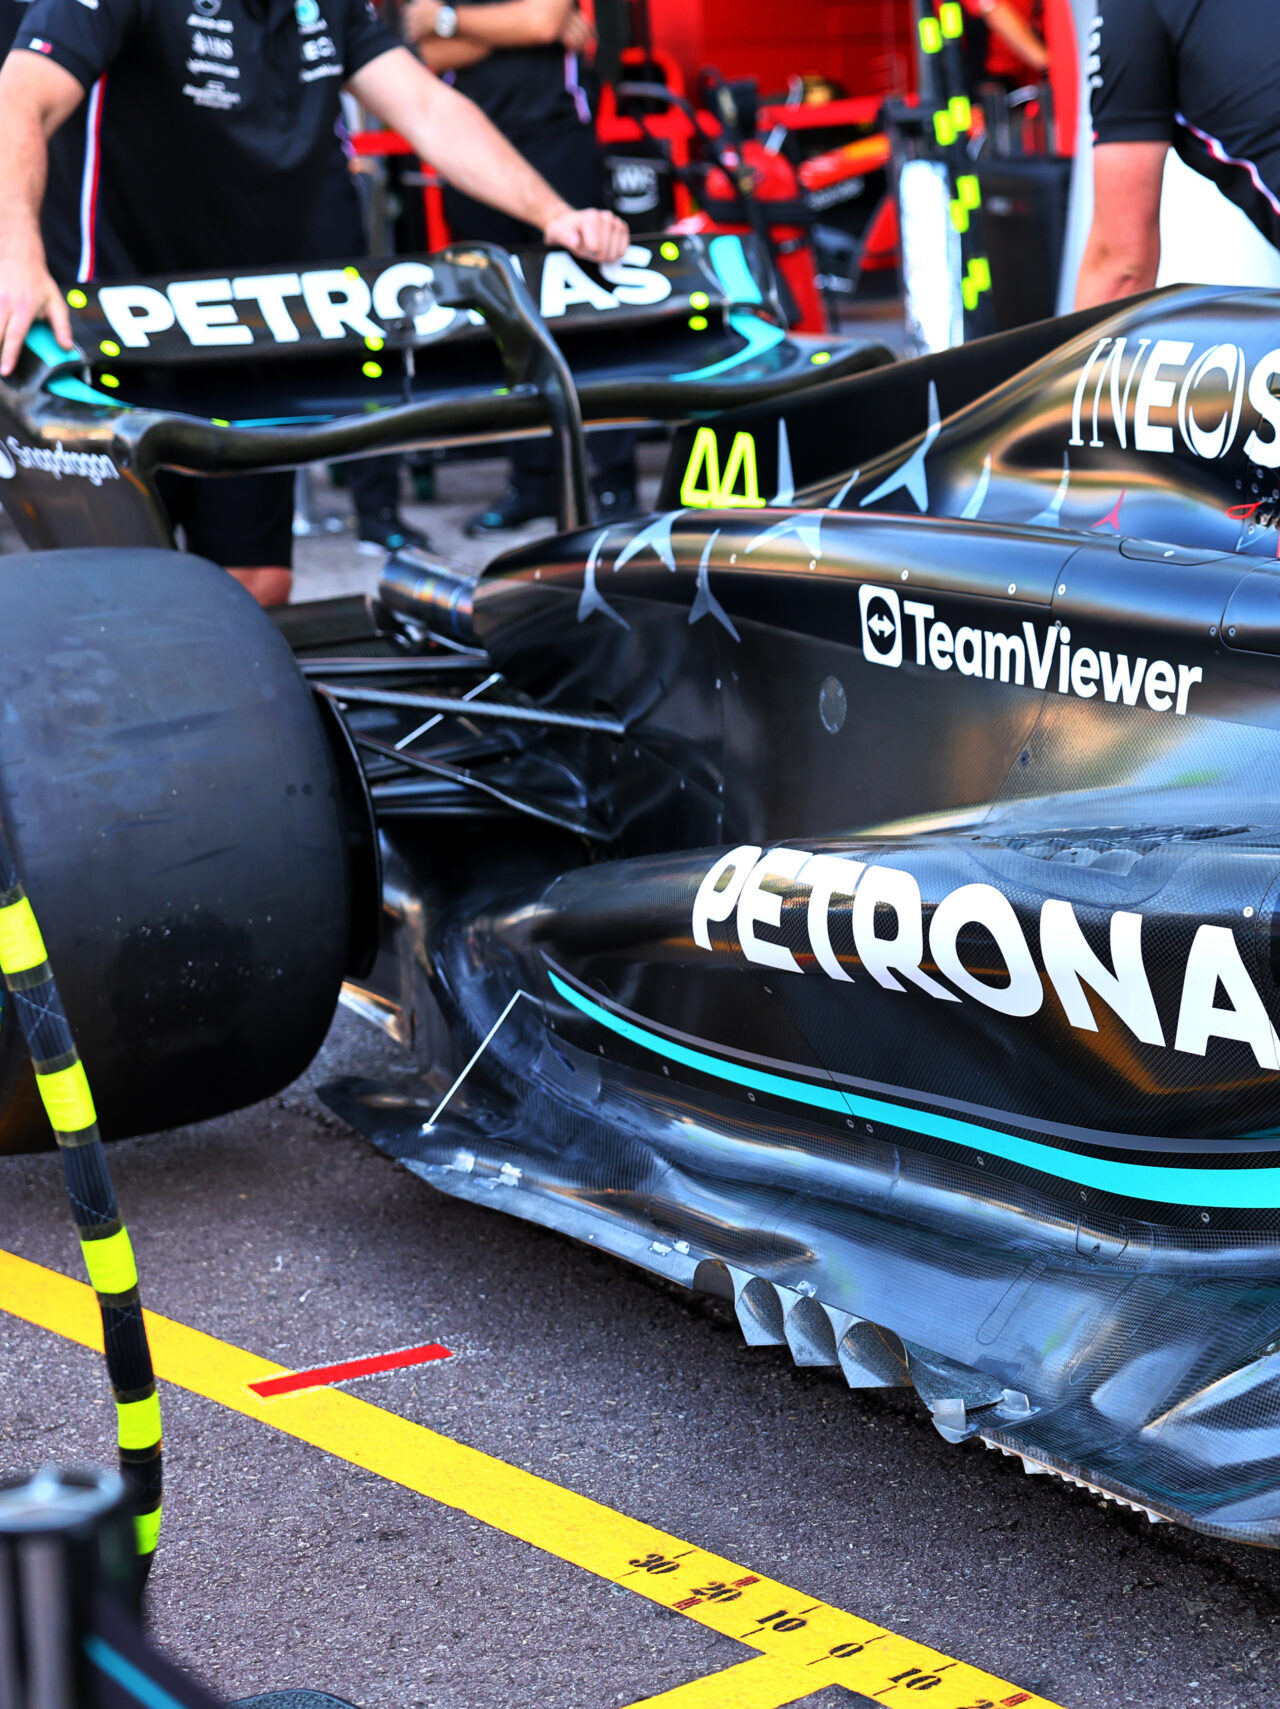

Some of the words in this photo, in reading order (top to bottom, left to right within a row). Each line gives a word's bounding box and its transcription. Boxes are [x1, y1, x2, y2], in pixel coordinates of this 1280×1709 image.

[98, 245, 672, 348] PETROAS
[6, 435, 120, 487] Snapdragon
[680, 426, 768, 509] 44
[903, 599, 1203, 716] TeamViewer
[629, 1554, 680, 1575] 30
[690, 1581, 743, 1604] 20
[755, 1609, 807, 1632] 10
[829, 1642, 864, 1658] 0
[888, 1668, 942, 1690] 10
